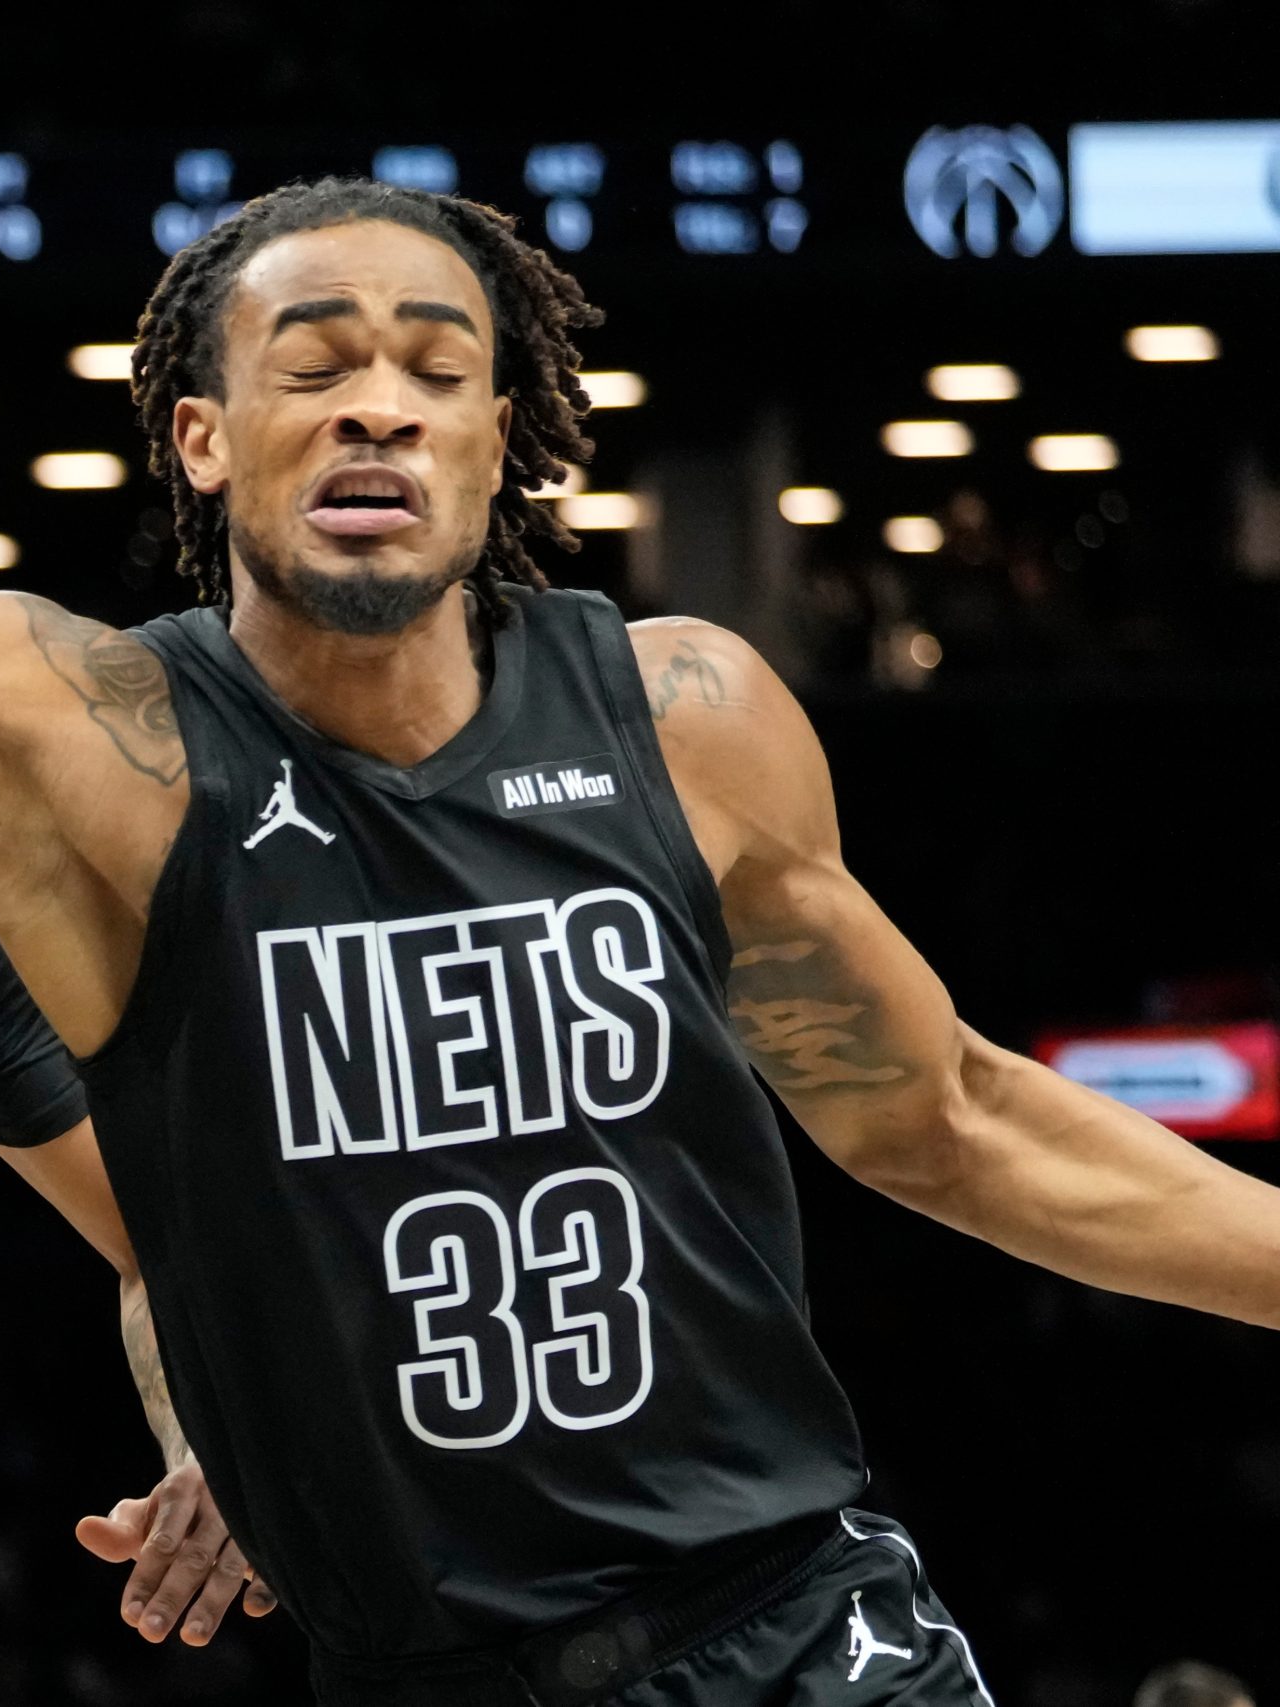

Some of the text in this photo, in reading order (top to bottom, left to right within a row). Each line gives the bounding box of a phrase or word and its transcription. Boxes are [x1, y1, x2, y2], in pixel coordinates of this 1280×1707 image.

[502, 769, 615, 809] All In Won
[257, 887, 669, 1161] NETS
[383, 1167, 653, 1449] 33
